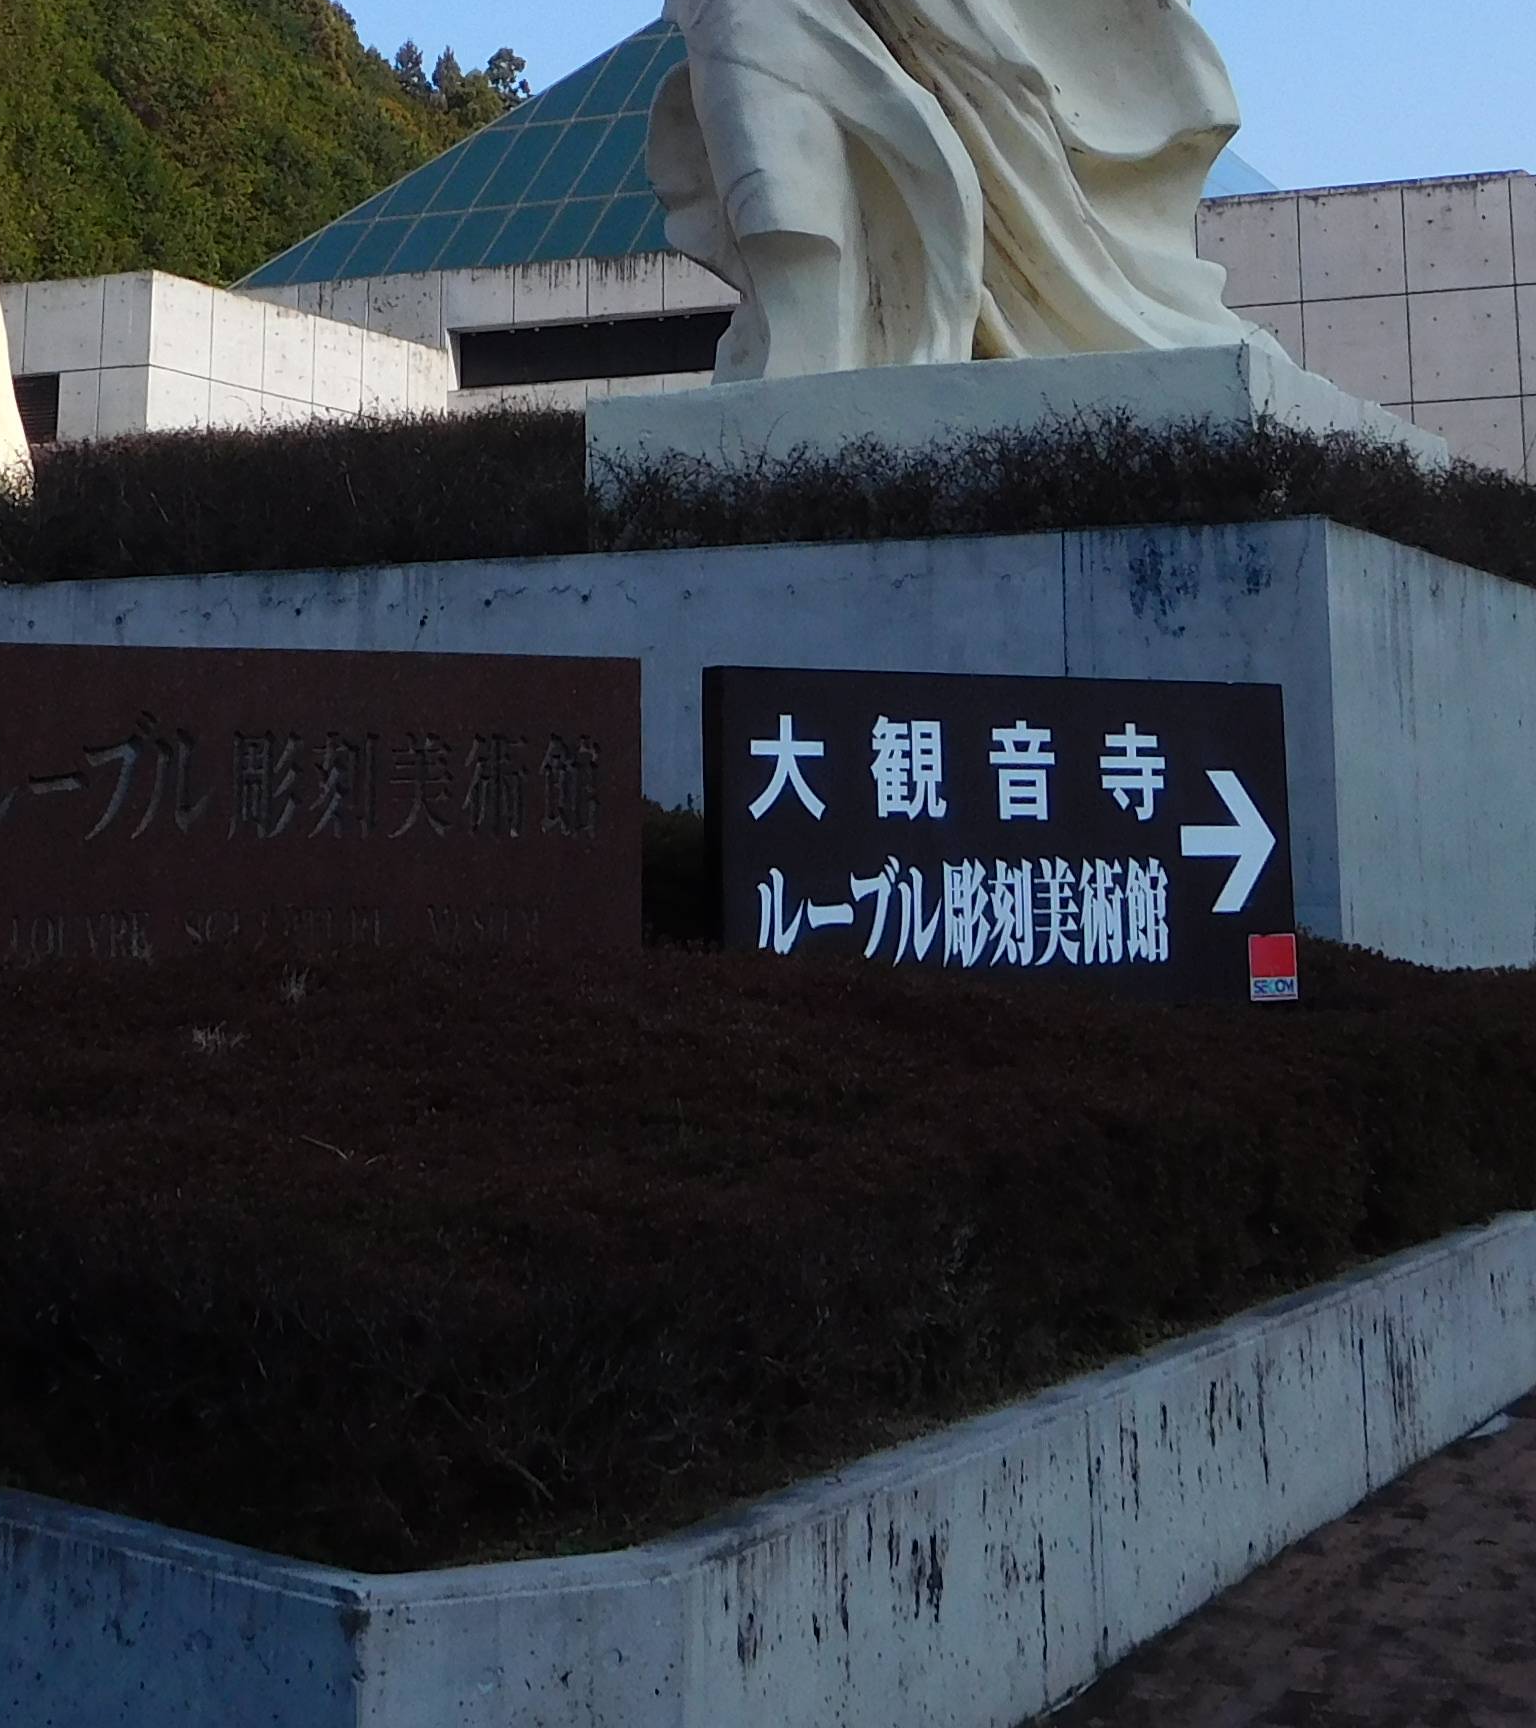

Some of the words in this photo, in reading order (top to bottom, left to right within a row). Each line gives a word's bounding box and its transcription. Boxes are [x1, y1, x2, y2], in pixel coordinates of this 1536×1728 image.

[748, 714, 1166, 822] 大観音寺
[757, 855, 1169, 968] ルーブル彫刻美術館
[1254, 979, 1295, 994] SECOM
